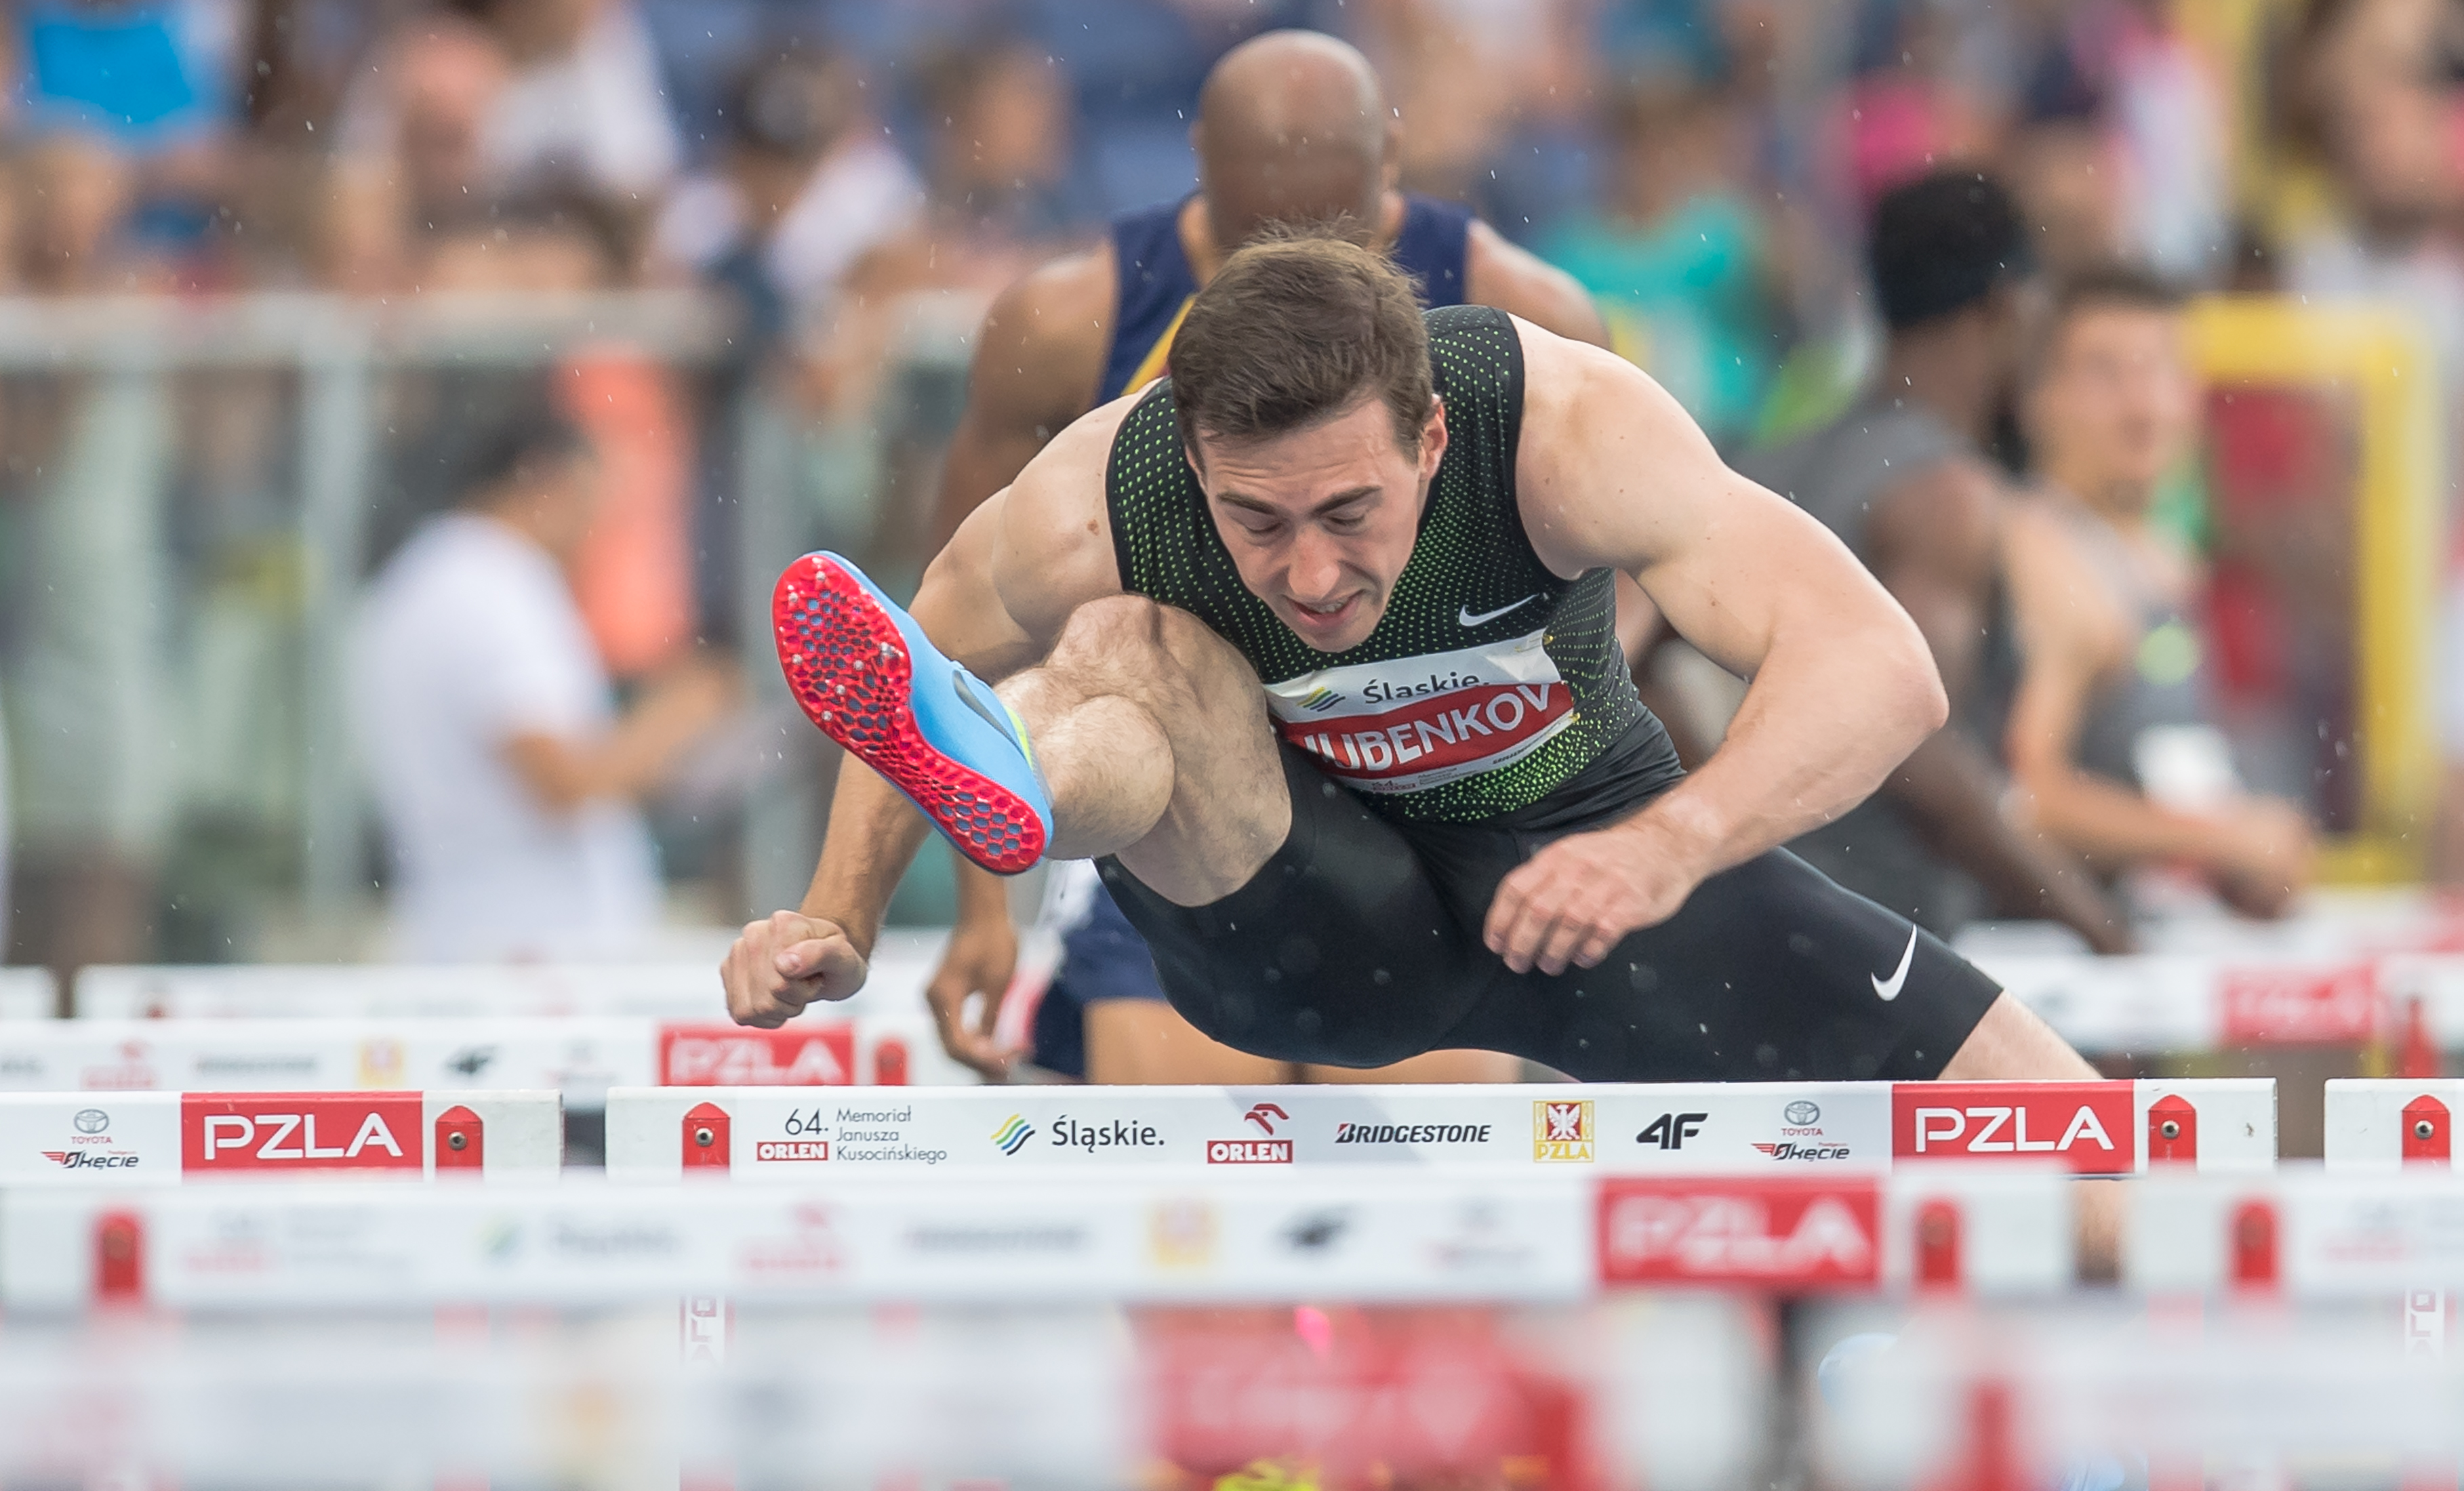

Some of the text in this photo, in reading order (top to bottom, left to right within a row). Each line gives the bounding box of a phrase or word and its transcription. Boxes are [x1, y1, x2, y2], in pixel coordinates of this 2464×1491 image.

[785, 1108, 829, 1136] 64.
[836, 1105, 912, 1122] Memoriał
[204, 1112, 403, 1160] PZLA
[836, 1126, 900, 1142] Janusza
[1051, 1114, 1165, 1153] Śląskie.
[1334, 1122, 1492, 1144] BRIDGESTONE
[1635, 1111, 1709, 1150] 4F
[1781, 1128, 1824, 1136] TOYOTA
[1916, 1105, 2115, 1152] PZLA
[71, 1136, 113, 1144] TOYOTA
[759, 1143, 826, 1160] ORLEN
[836, 1143, 948, 1165] Kusocińskiego
[1210, 1142, 1289, 1162] ORLEN
[1537, 1143, 1590, 1160] PZLA
